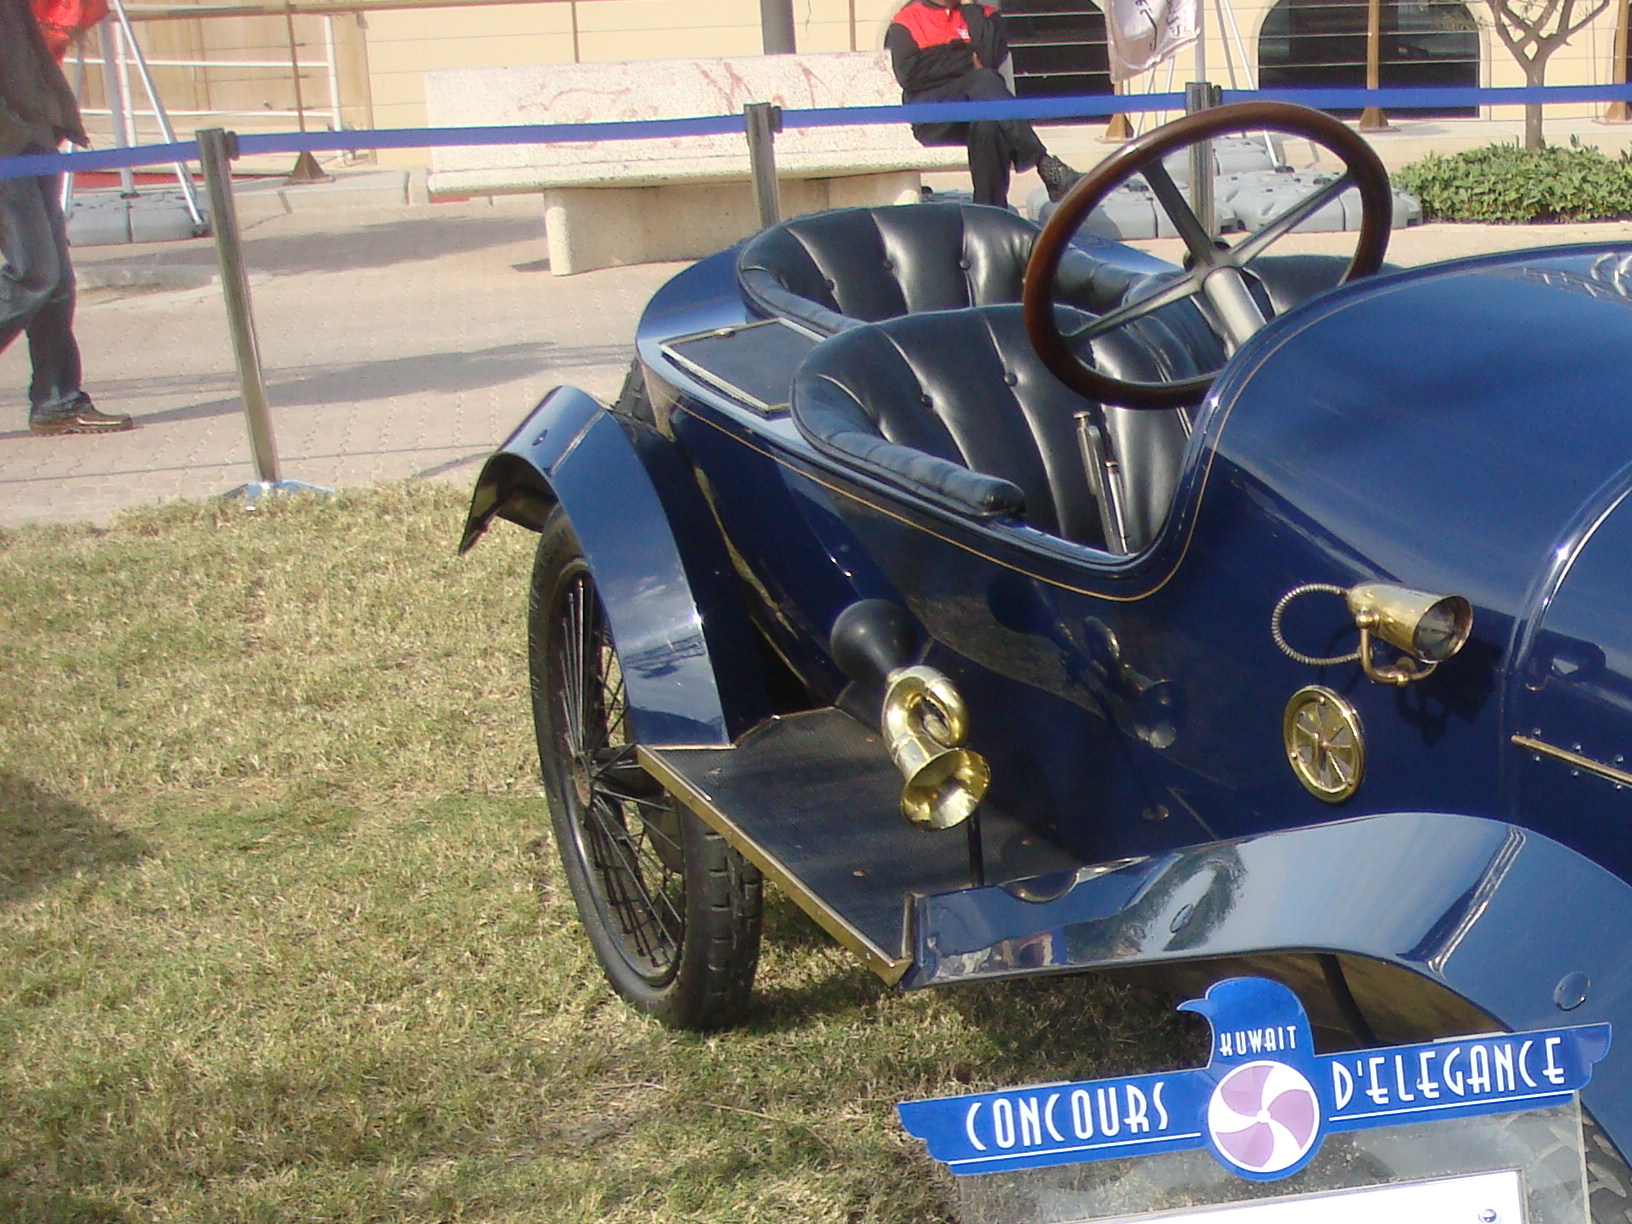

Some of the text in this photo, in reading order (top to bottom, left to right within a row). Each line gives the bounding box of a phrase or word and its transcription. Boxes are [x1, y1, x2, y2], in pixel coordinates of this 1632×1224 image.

[1219, 1025, 1298, 1057] KUWAIT
[965, 1036, 1566, 1151] CONCOURS D'ELEGANCE
